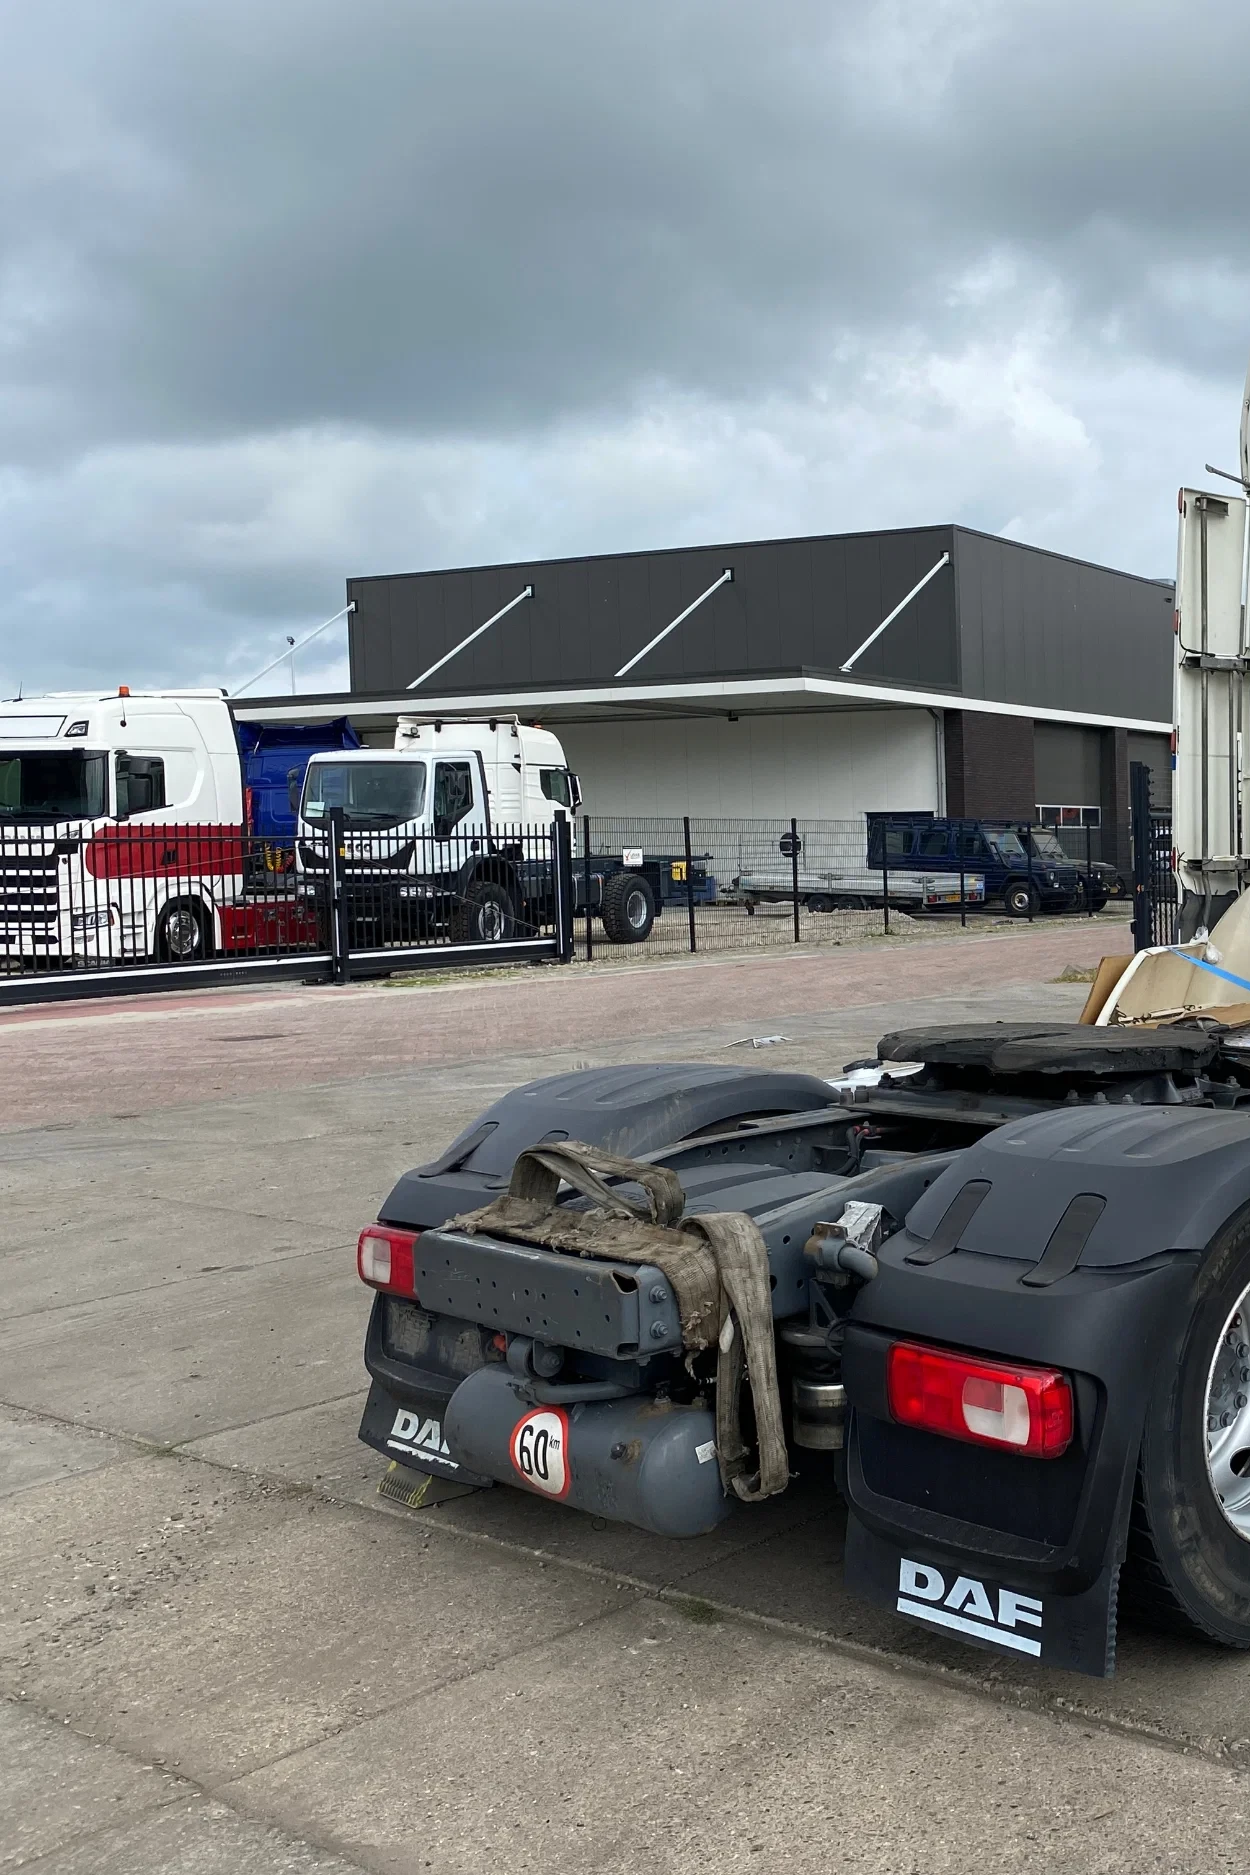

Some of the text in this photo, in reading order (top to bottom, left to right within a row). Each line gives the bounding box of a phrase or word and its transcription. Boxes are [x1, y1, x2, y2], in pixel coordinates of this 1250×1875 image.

[390, 1408, 451, 1455] DA
[519, 1424, 561, 1481] 60 km
[899, 1557, 1043, 1628] DAF
